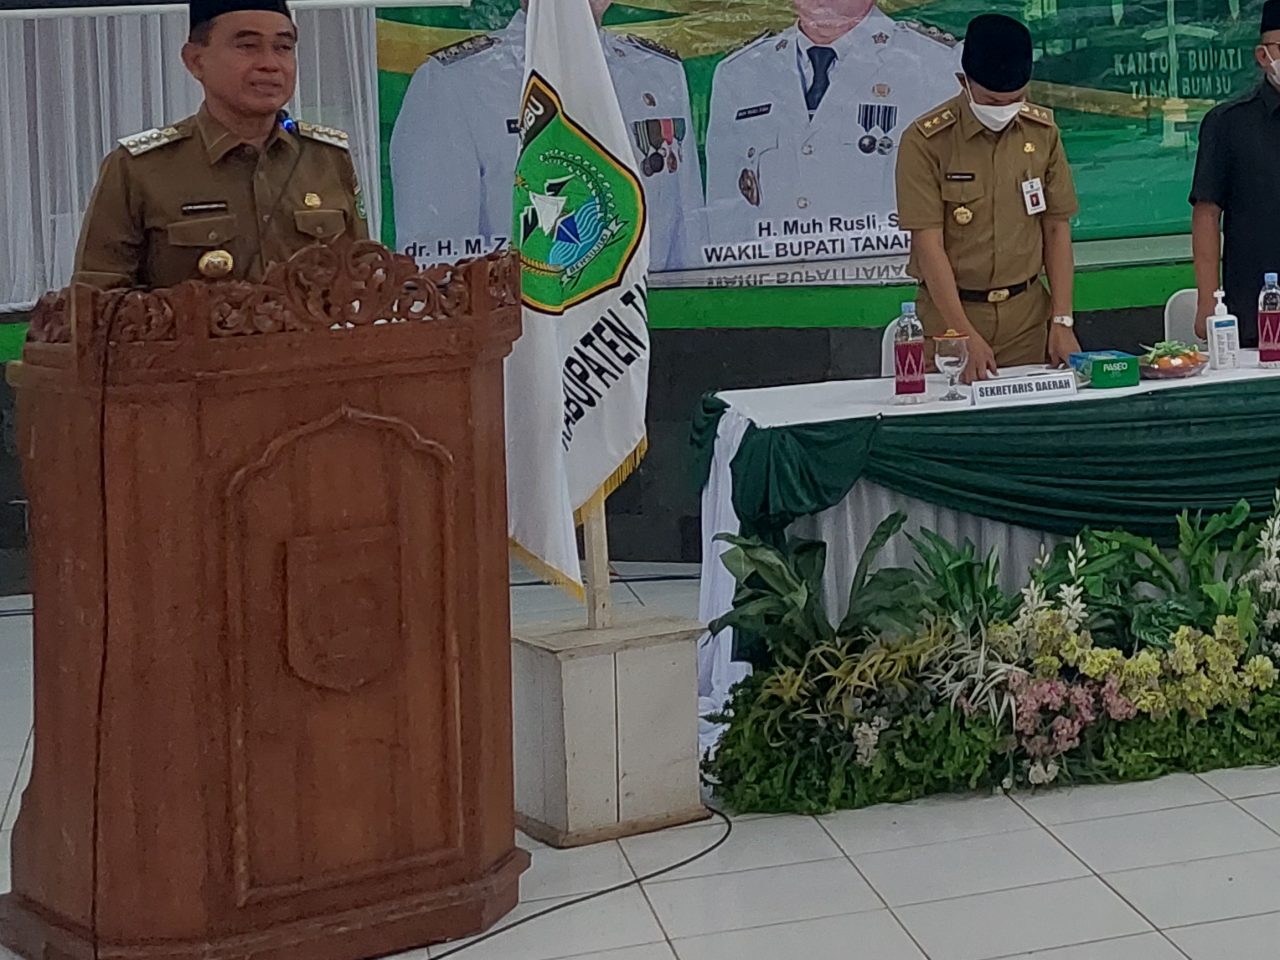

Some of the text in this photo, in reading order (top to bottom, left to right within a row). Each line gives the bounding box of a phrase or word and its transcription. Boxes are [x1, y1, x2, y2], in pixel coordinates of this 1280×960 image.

[1130, 78, 1177, 99] TANA
[758, 221, 777, 237] H.
[784, 219, 822, 235] Muh
[830, 214, 881, 232] Rusli,
[405, 242, 430, 257] dr.
[438, 240, 457, 256] H.
[465, 239, 487, 254] M.
[704, 244, 769, 263] WAKIL
[775, 238, 845, 258] BUPATI
[1103, 362, 1128, 372] PASEO
[979, 379, 1071, 397] SEKRETARIS DAERAH
